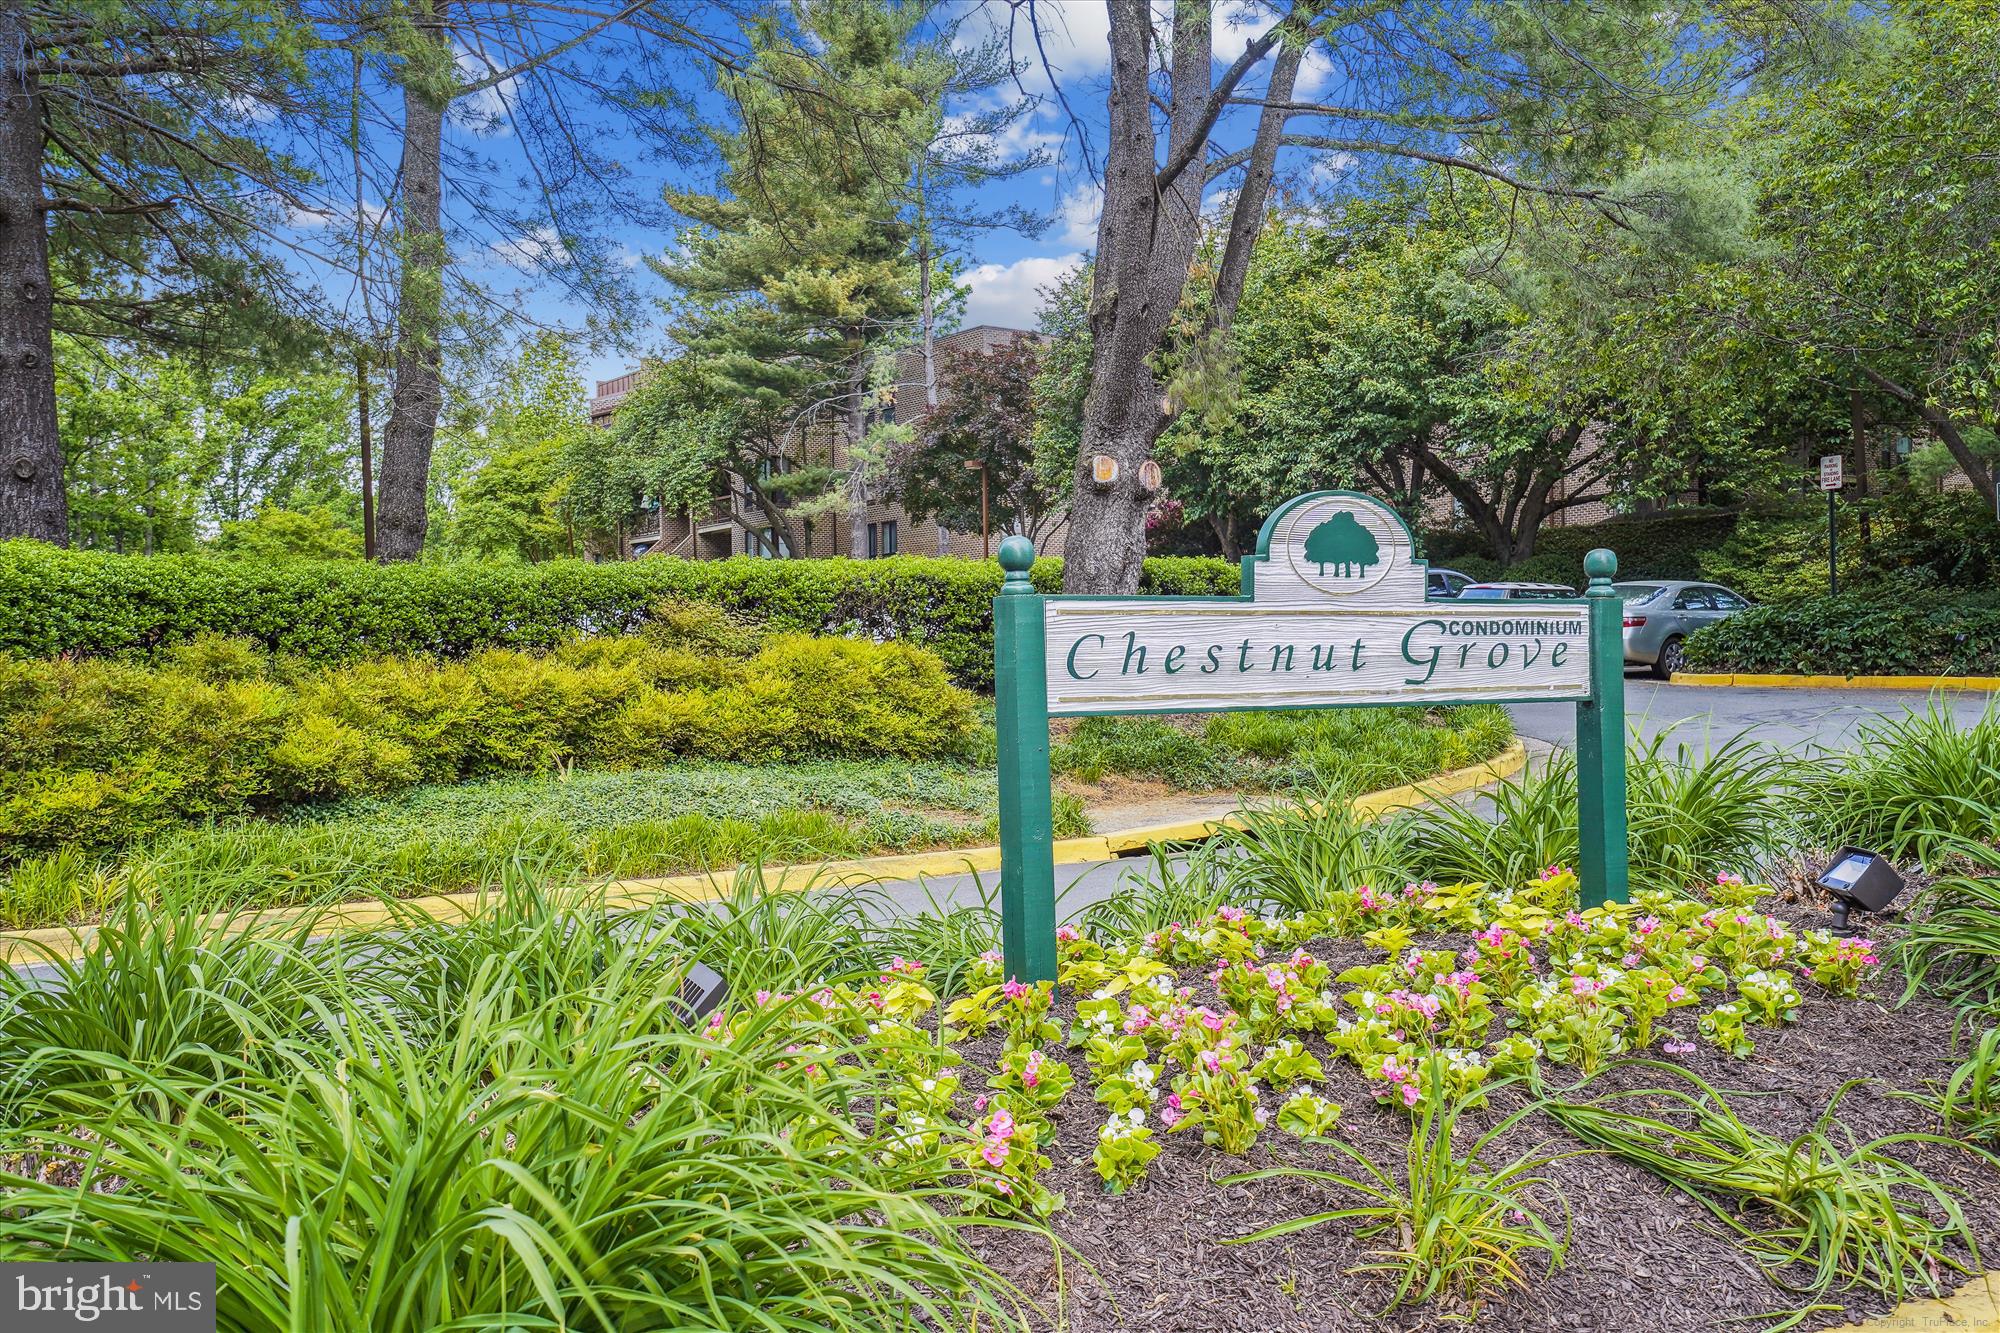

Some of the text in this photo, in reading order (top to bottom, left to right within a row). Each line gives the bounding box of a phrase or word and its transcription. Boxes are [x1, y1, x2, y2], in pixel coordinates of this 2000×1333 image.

[1448, 620, 1582, 636] CONDOMINIUM
[1066, 619, 1568, 685] Chestnut Grove
